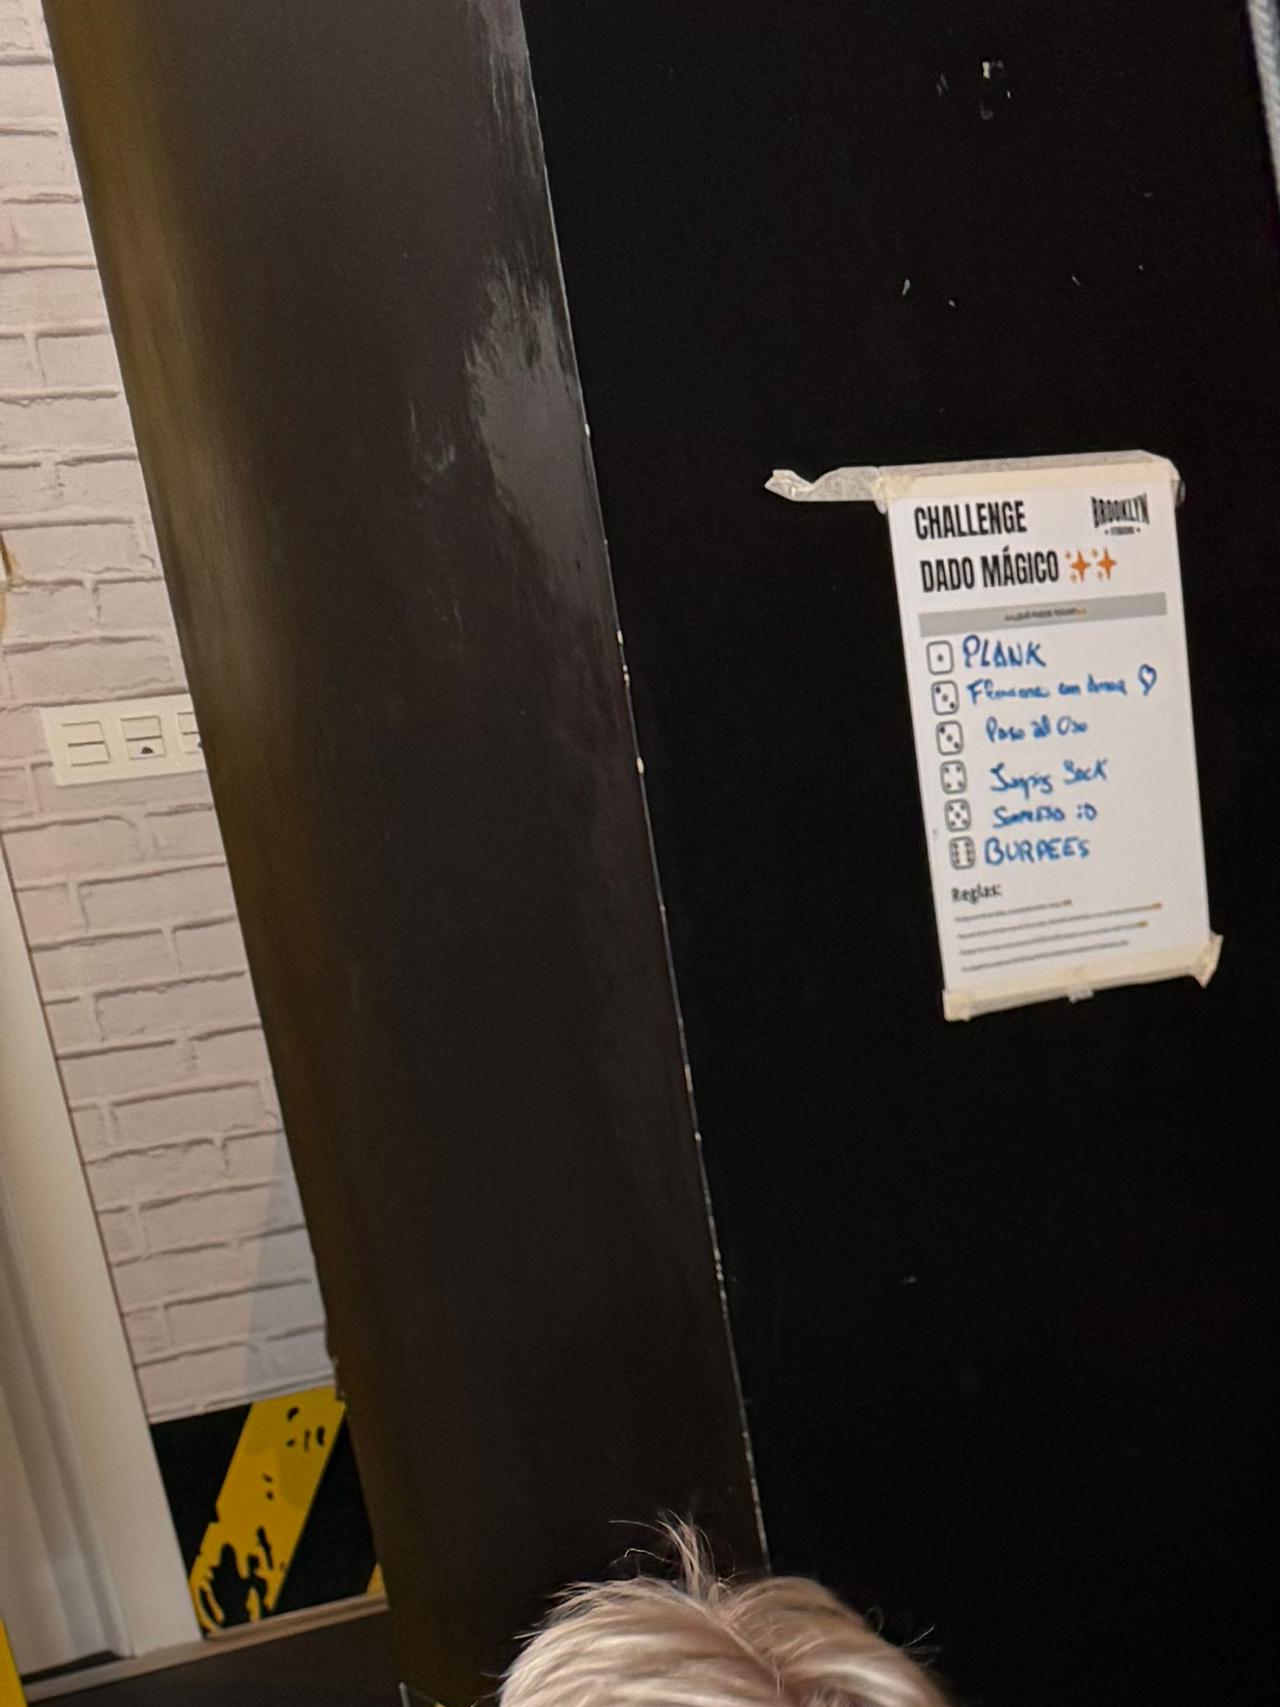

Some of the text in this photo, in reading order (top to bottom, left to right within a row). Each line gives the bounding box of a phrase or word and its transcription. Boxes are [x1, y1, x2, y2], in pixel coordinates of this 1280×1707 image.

[914, 500, 1027, 540] CHALLENGE
[921, 546, 1059, 593] DADO MÁGICO
[962, 634, 1047, 667] PLANK
[984, 836, 1090, 866] BURPEES
